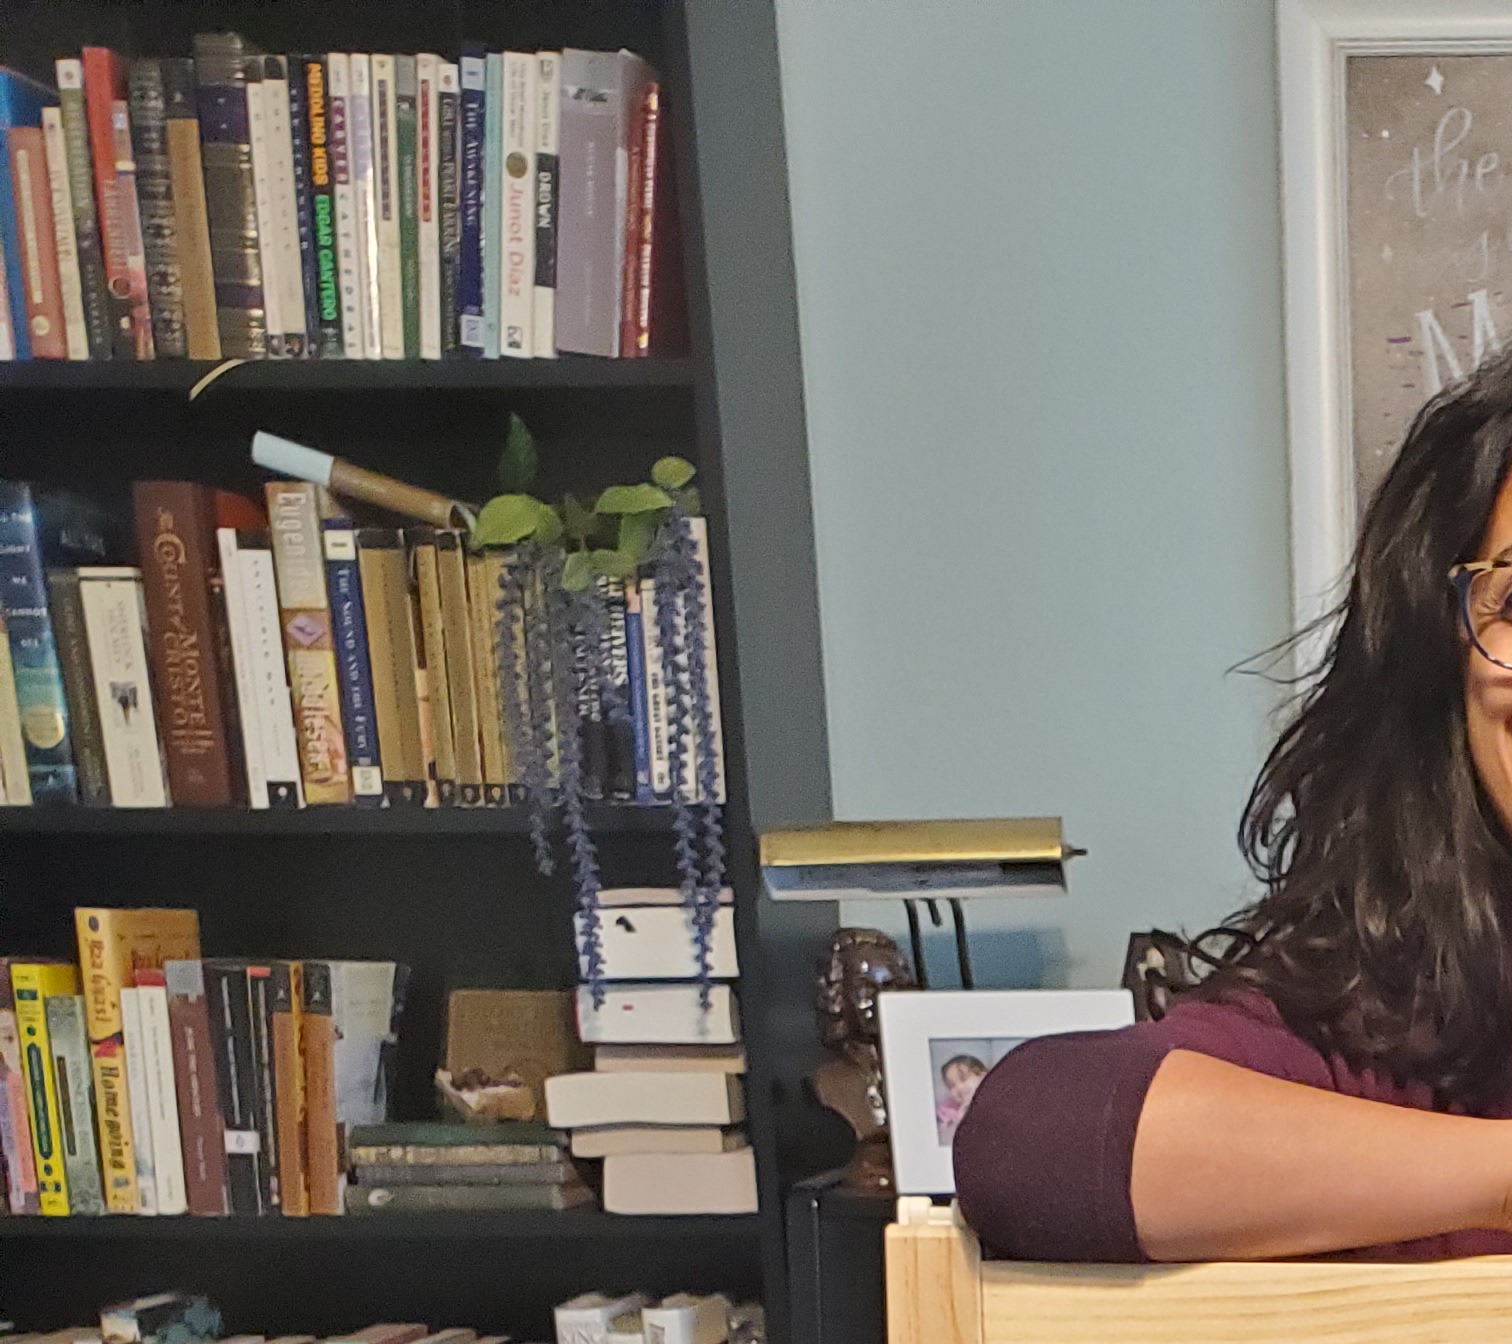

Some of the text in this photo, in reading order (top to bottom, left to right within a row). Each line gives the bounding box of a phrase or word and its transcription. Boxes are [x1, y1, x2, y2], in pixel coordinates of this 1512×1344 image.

[312, 147, 328, 185] KIDS
[538, 172, 551, 228] DROWN
[314, 194, 337, 321] EDGAR CANTERO
